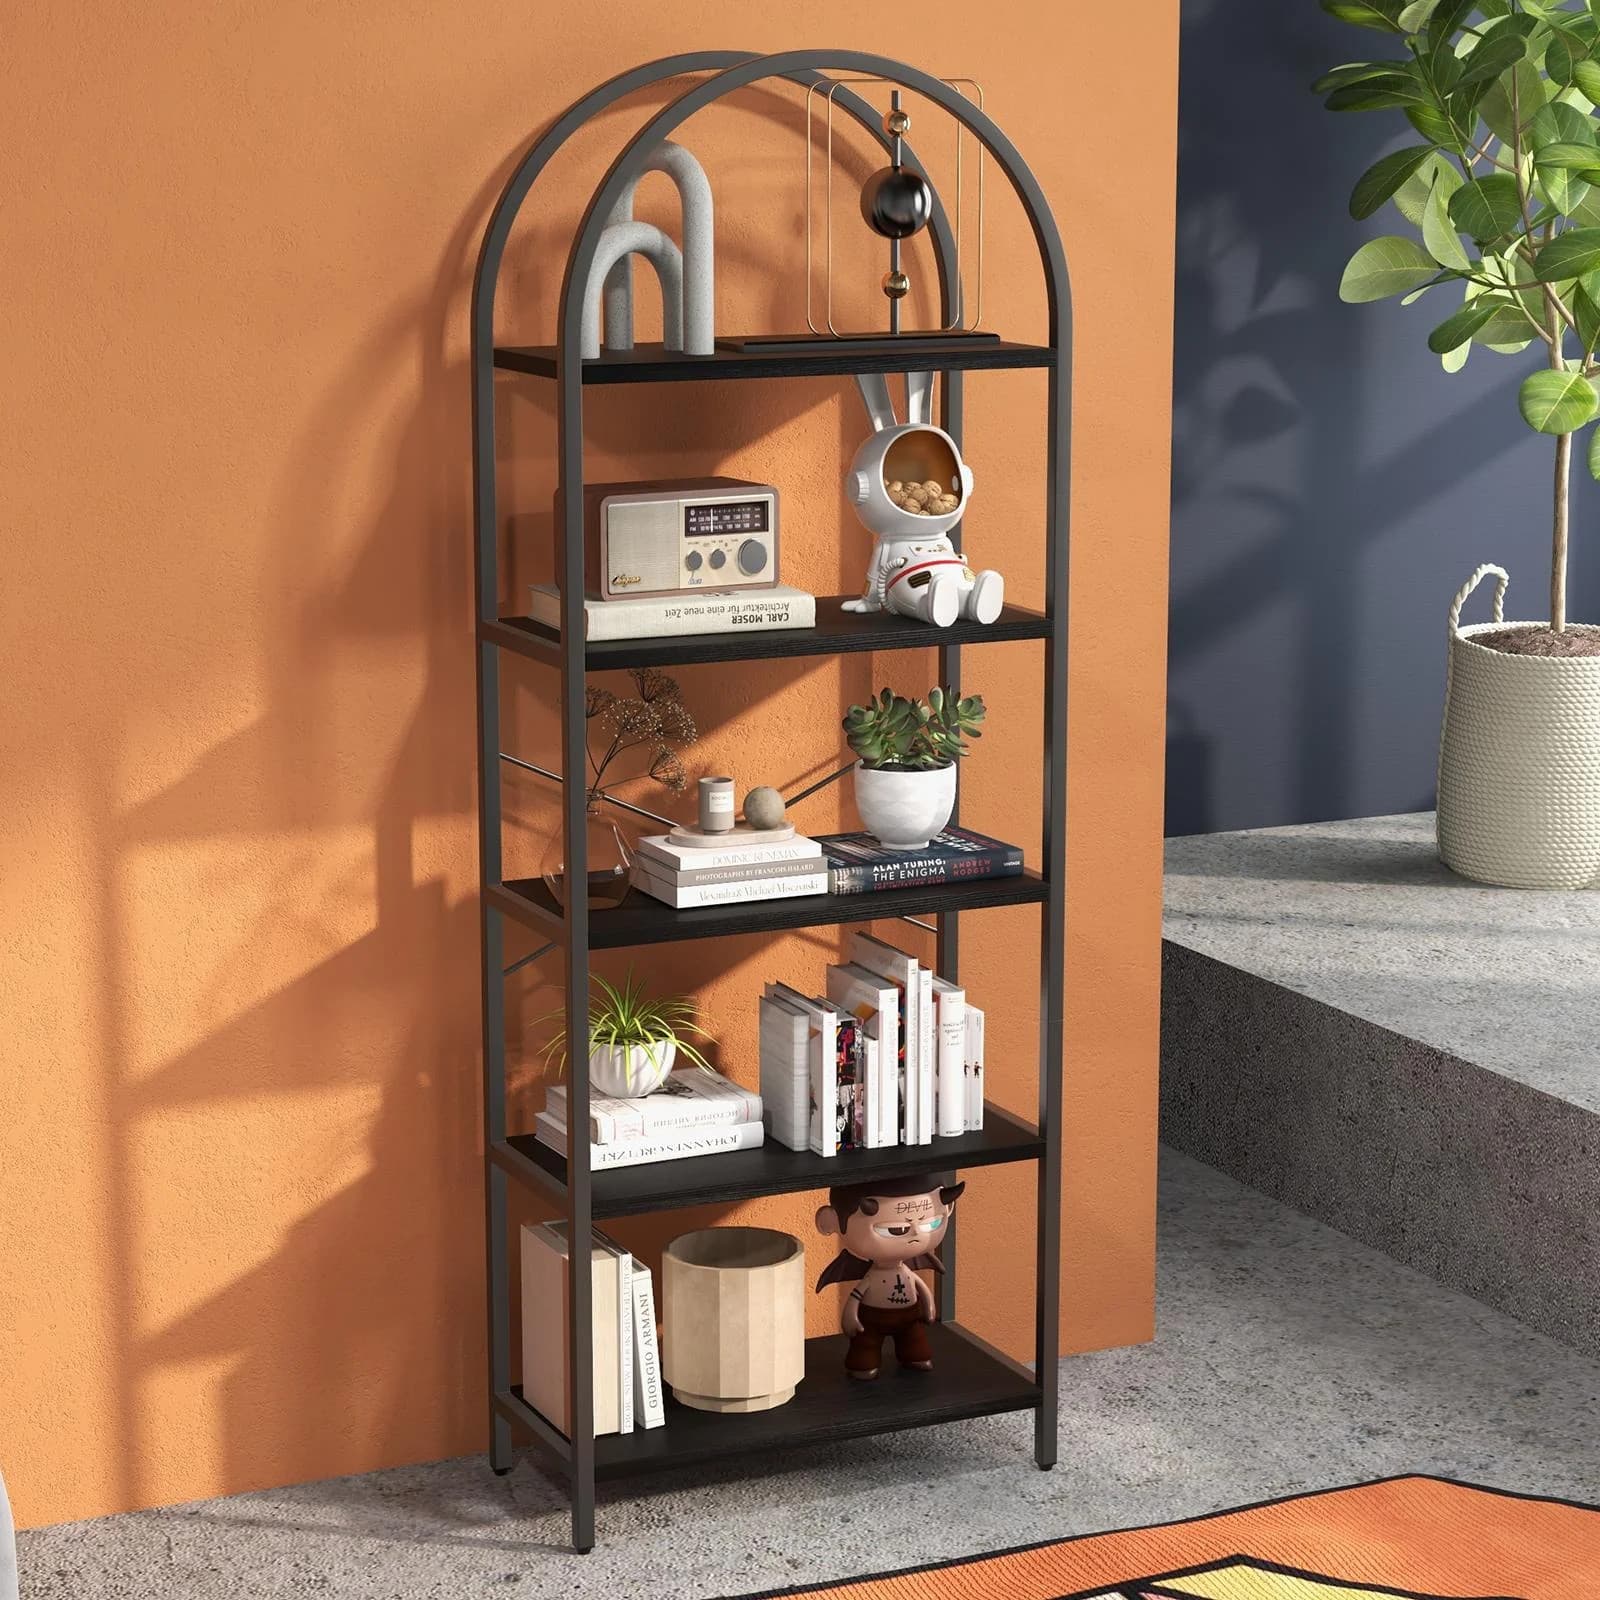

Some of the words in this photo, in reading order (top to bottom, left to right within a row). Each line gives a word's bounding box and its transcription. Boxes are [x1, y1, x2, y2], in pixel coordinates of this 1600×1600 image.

[664, 608, 682, 618] Zeit
[683, 607, 704, 616] neue
[706, 605, 725, 615] eine
[727, 604, 740, 614] für
[743, 602, 790, 613] Architektur
[731, 614, 763, 624] MOSER
[767, 612, 789, 623] CARL
[872, 863, 900, 873] ALAN
[952, 859, 991, 870] ANDREW
[695, 871, 744, 881] PHOTOGRAPHS
[787, 863, 815, 872] HALARD
[873, 871, 895, 882] THE
[900, 867, 946, 880] ENIGMA
[952, 866, 991, 877] HODGES
[639, 1293, 653, 1347] ARMANI
[643, 1351, 658, 1409] GIORGIO
